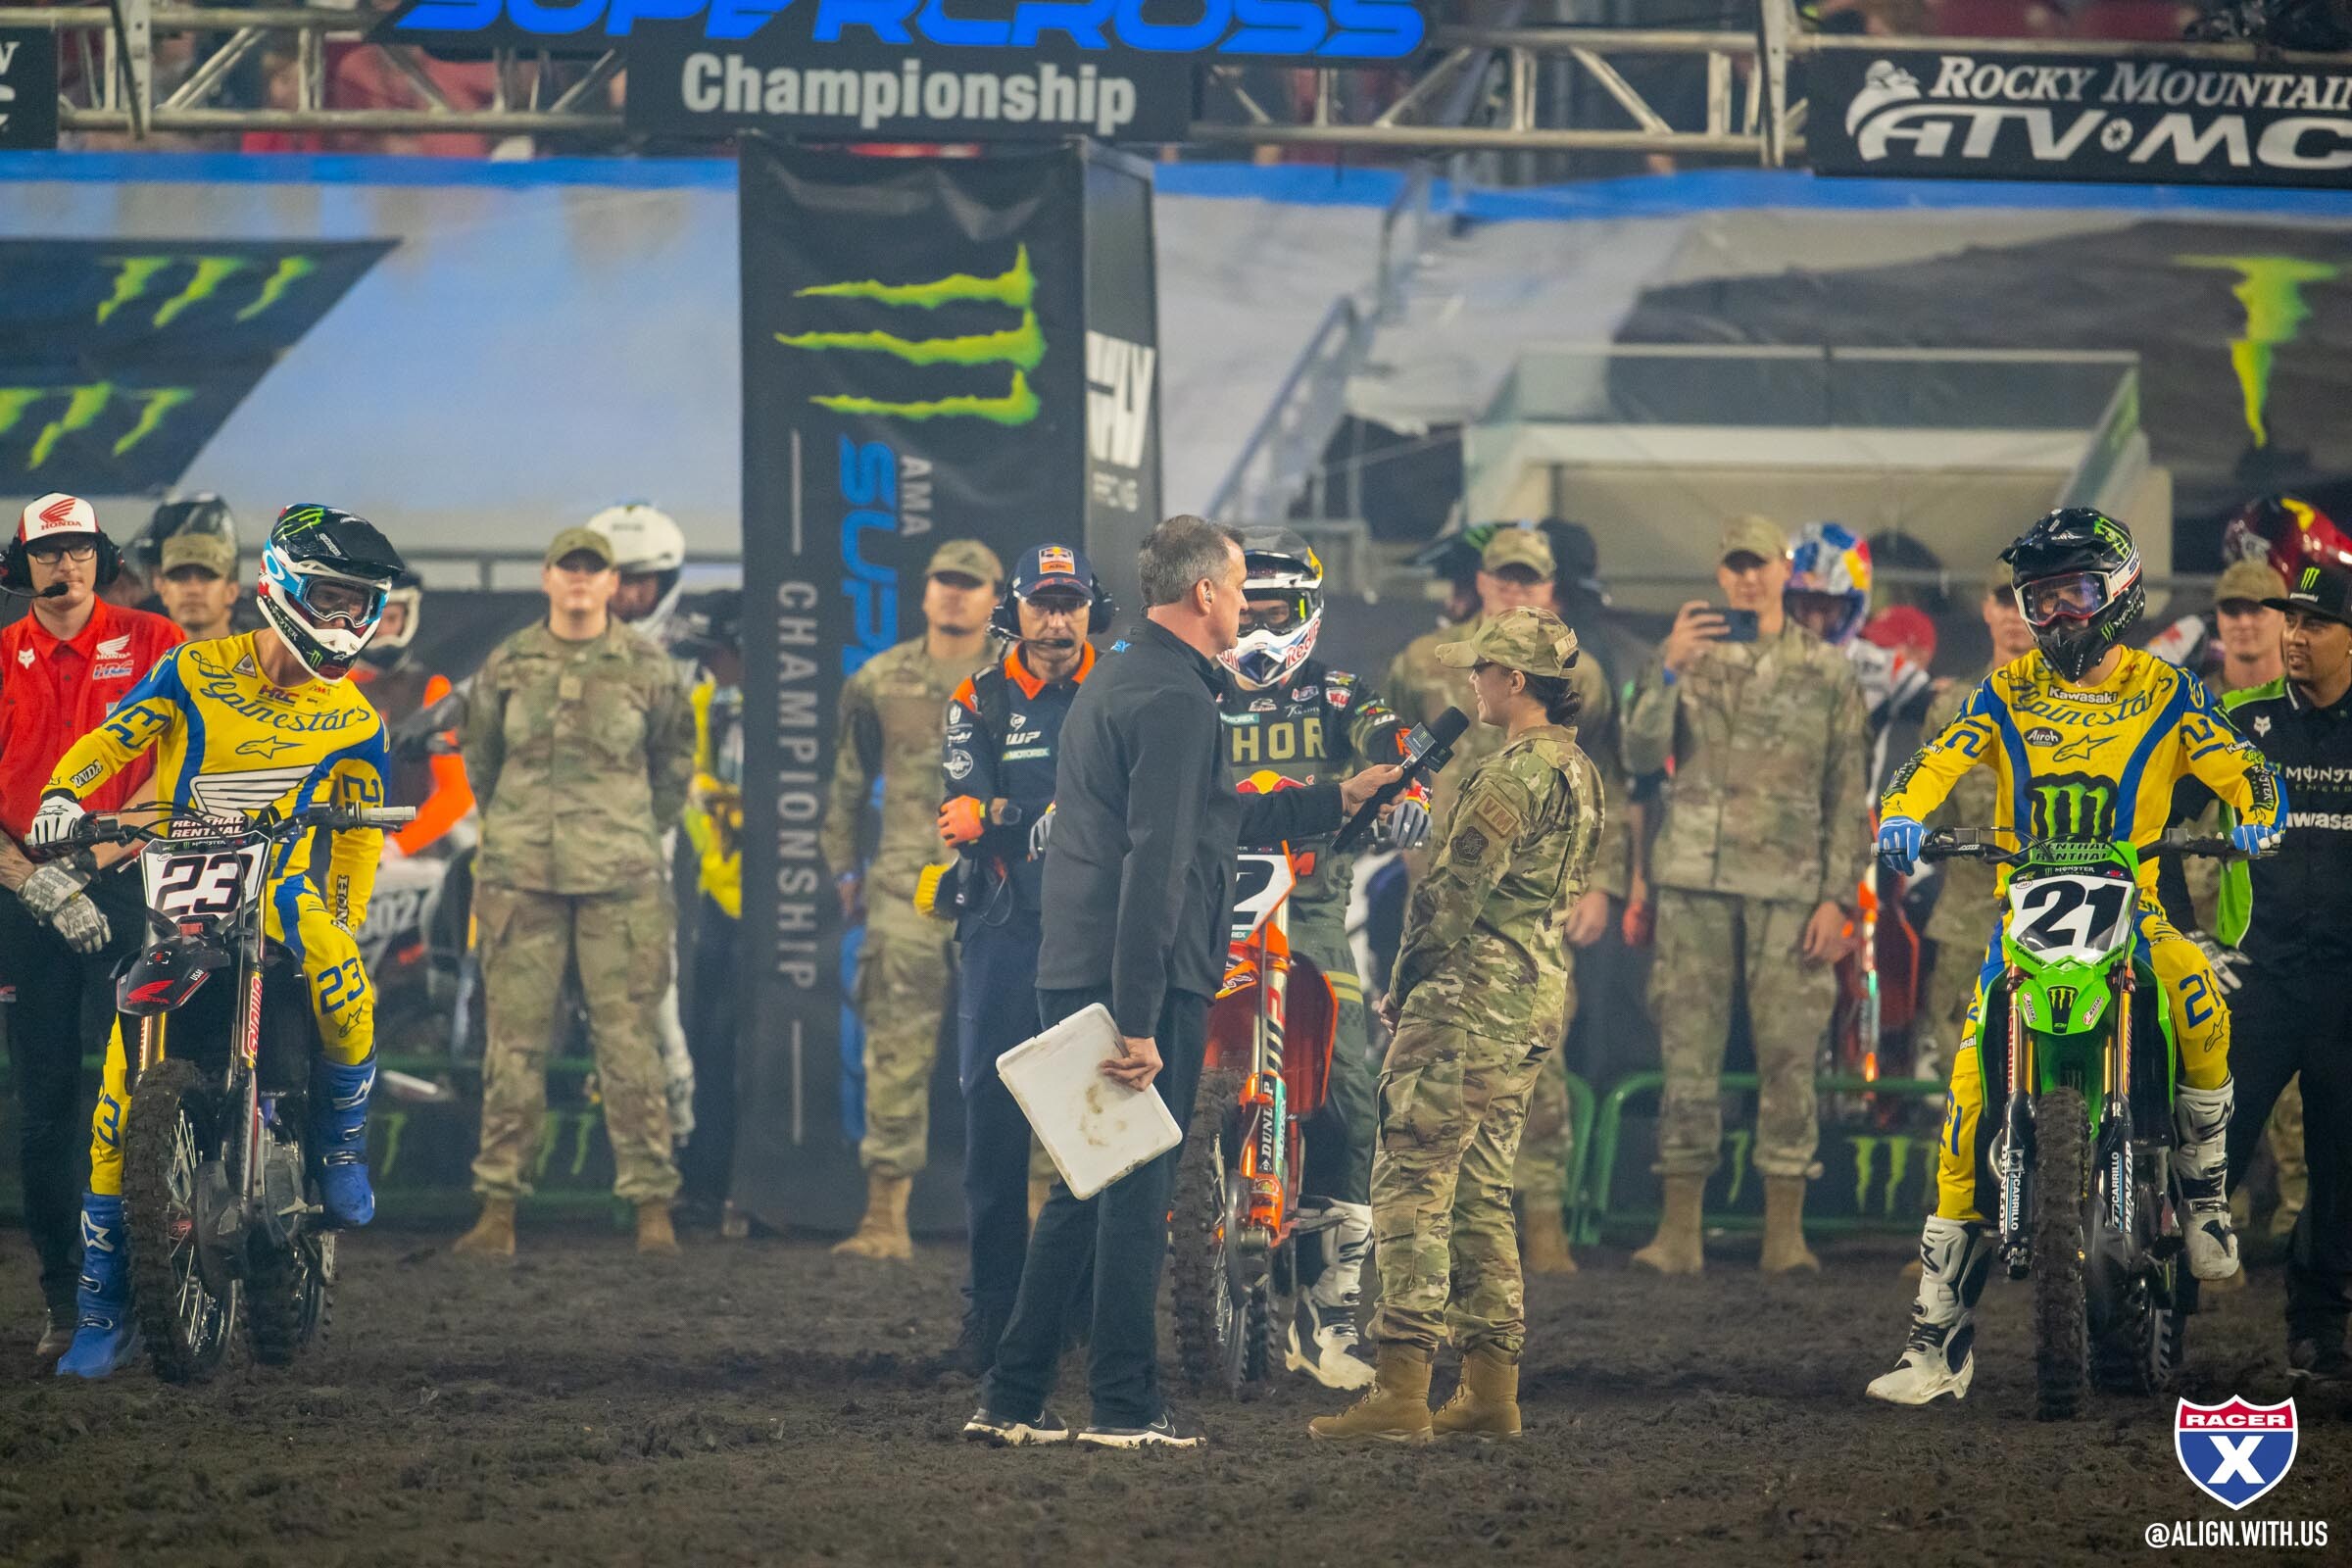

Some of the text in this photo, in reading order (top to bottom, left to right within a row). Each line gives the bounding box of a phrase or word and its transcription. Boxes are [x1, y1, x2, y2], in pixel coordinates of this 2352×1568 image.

[681, 52, 1137, 135] Championship
[1928, 56, 2097, 103] ROCKY
[901, 455, 932, 536] AMA
[41, 520, 82, 531] HONDA
[96, 651, 131, 661] HONDA
[2049, 686, 2118, 704] Kawasaki
[1005, 730, 1042, 746] WP
[1232, 717, 1328, 762] HOR
[2027, 728, 2059, 742] Airoh
[777, 580, 819, 989] CHAMPIONSHIP
[154, 854, 254, 918] 23
[2016, 880, 2128, 953] 21
[317, 956, 365, 1015] 23
[1260, 1081, 1277, 1159] DUNLP
[1999, 1144, 2009, 1235] DUNLOP
[2010, 1176, 2021, 1231] CARRILLO
[2111, 1152, 2120, 1203] CARRILLO
[2125, 1141, 2133, 1234] DUNLOP
